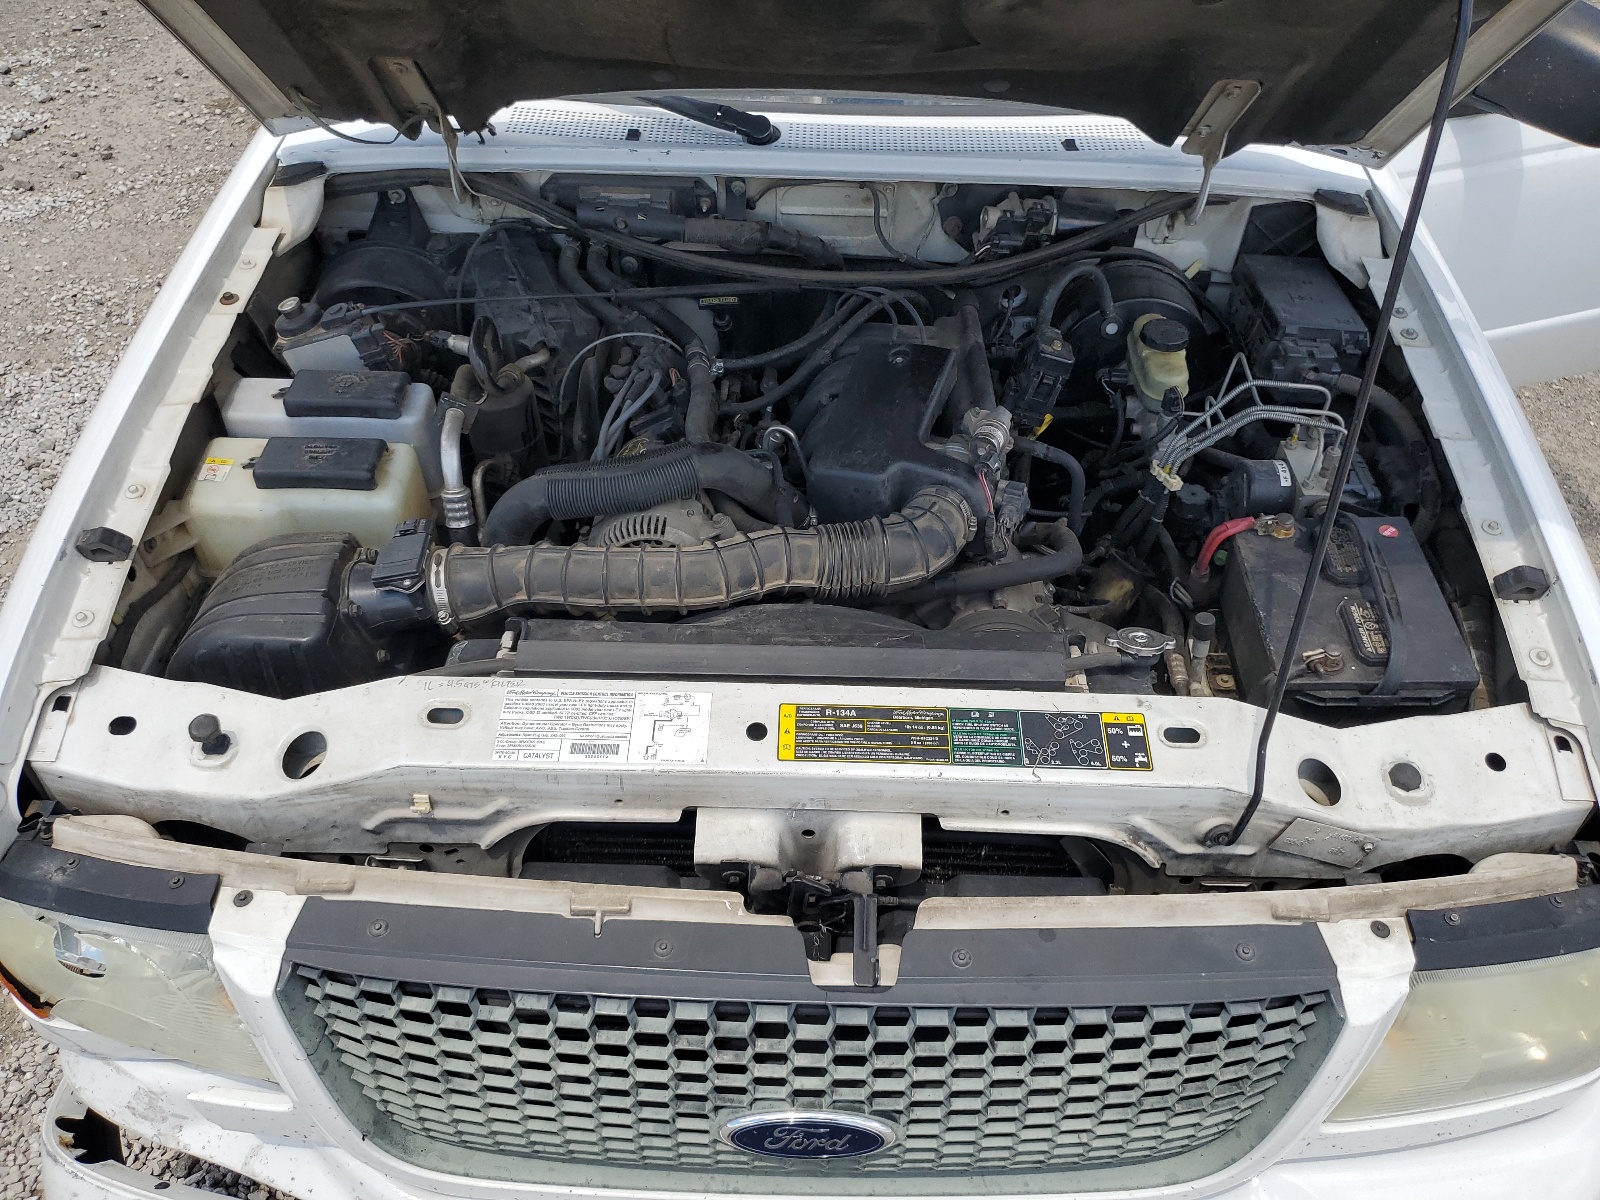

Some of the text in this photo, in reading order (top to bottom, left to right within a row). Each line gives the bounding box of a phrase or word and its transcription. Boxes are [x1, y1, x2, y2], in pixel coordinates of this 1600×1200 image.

[825, 708, 857, 717] R-134A
[1107, 727, 1124, 735] 50%
[764, 1126, 852, 1151] Ford
